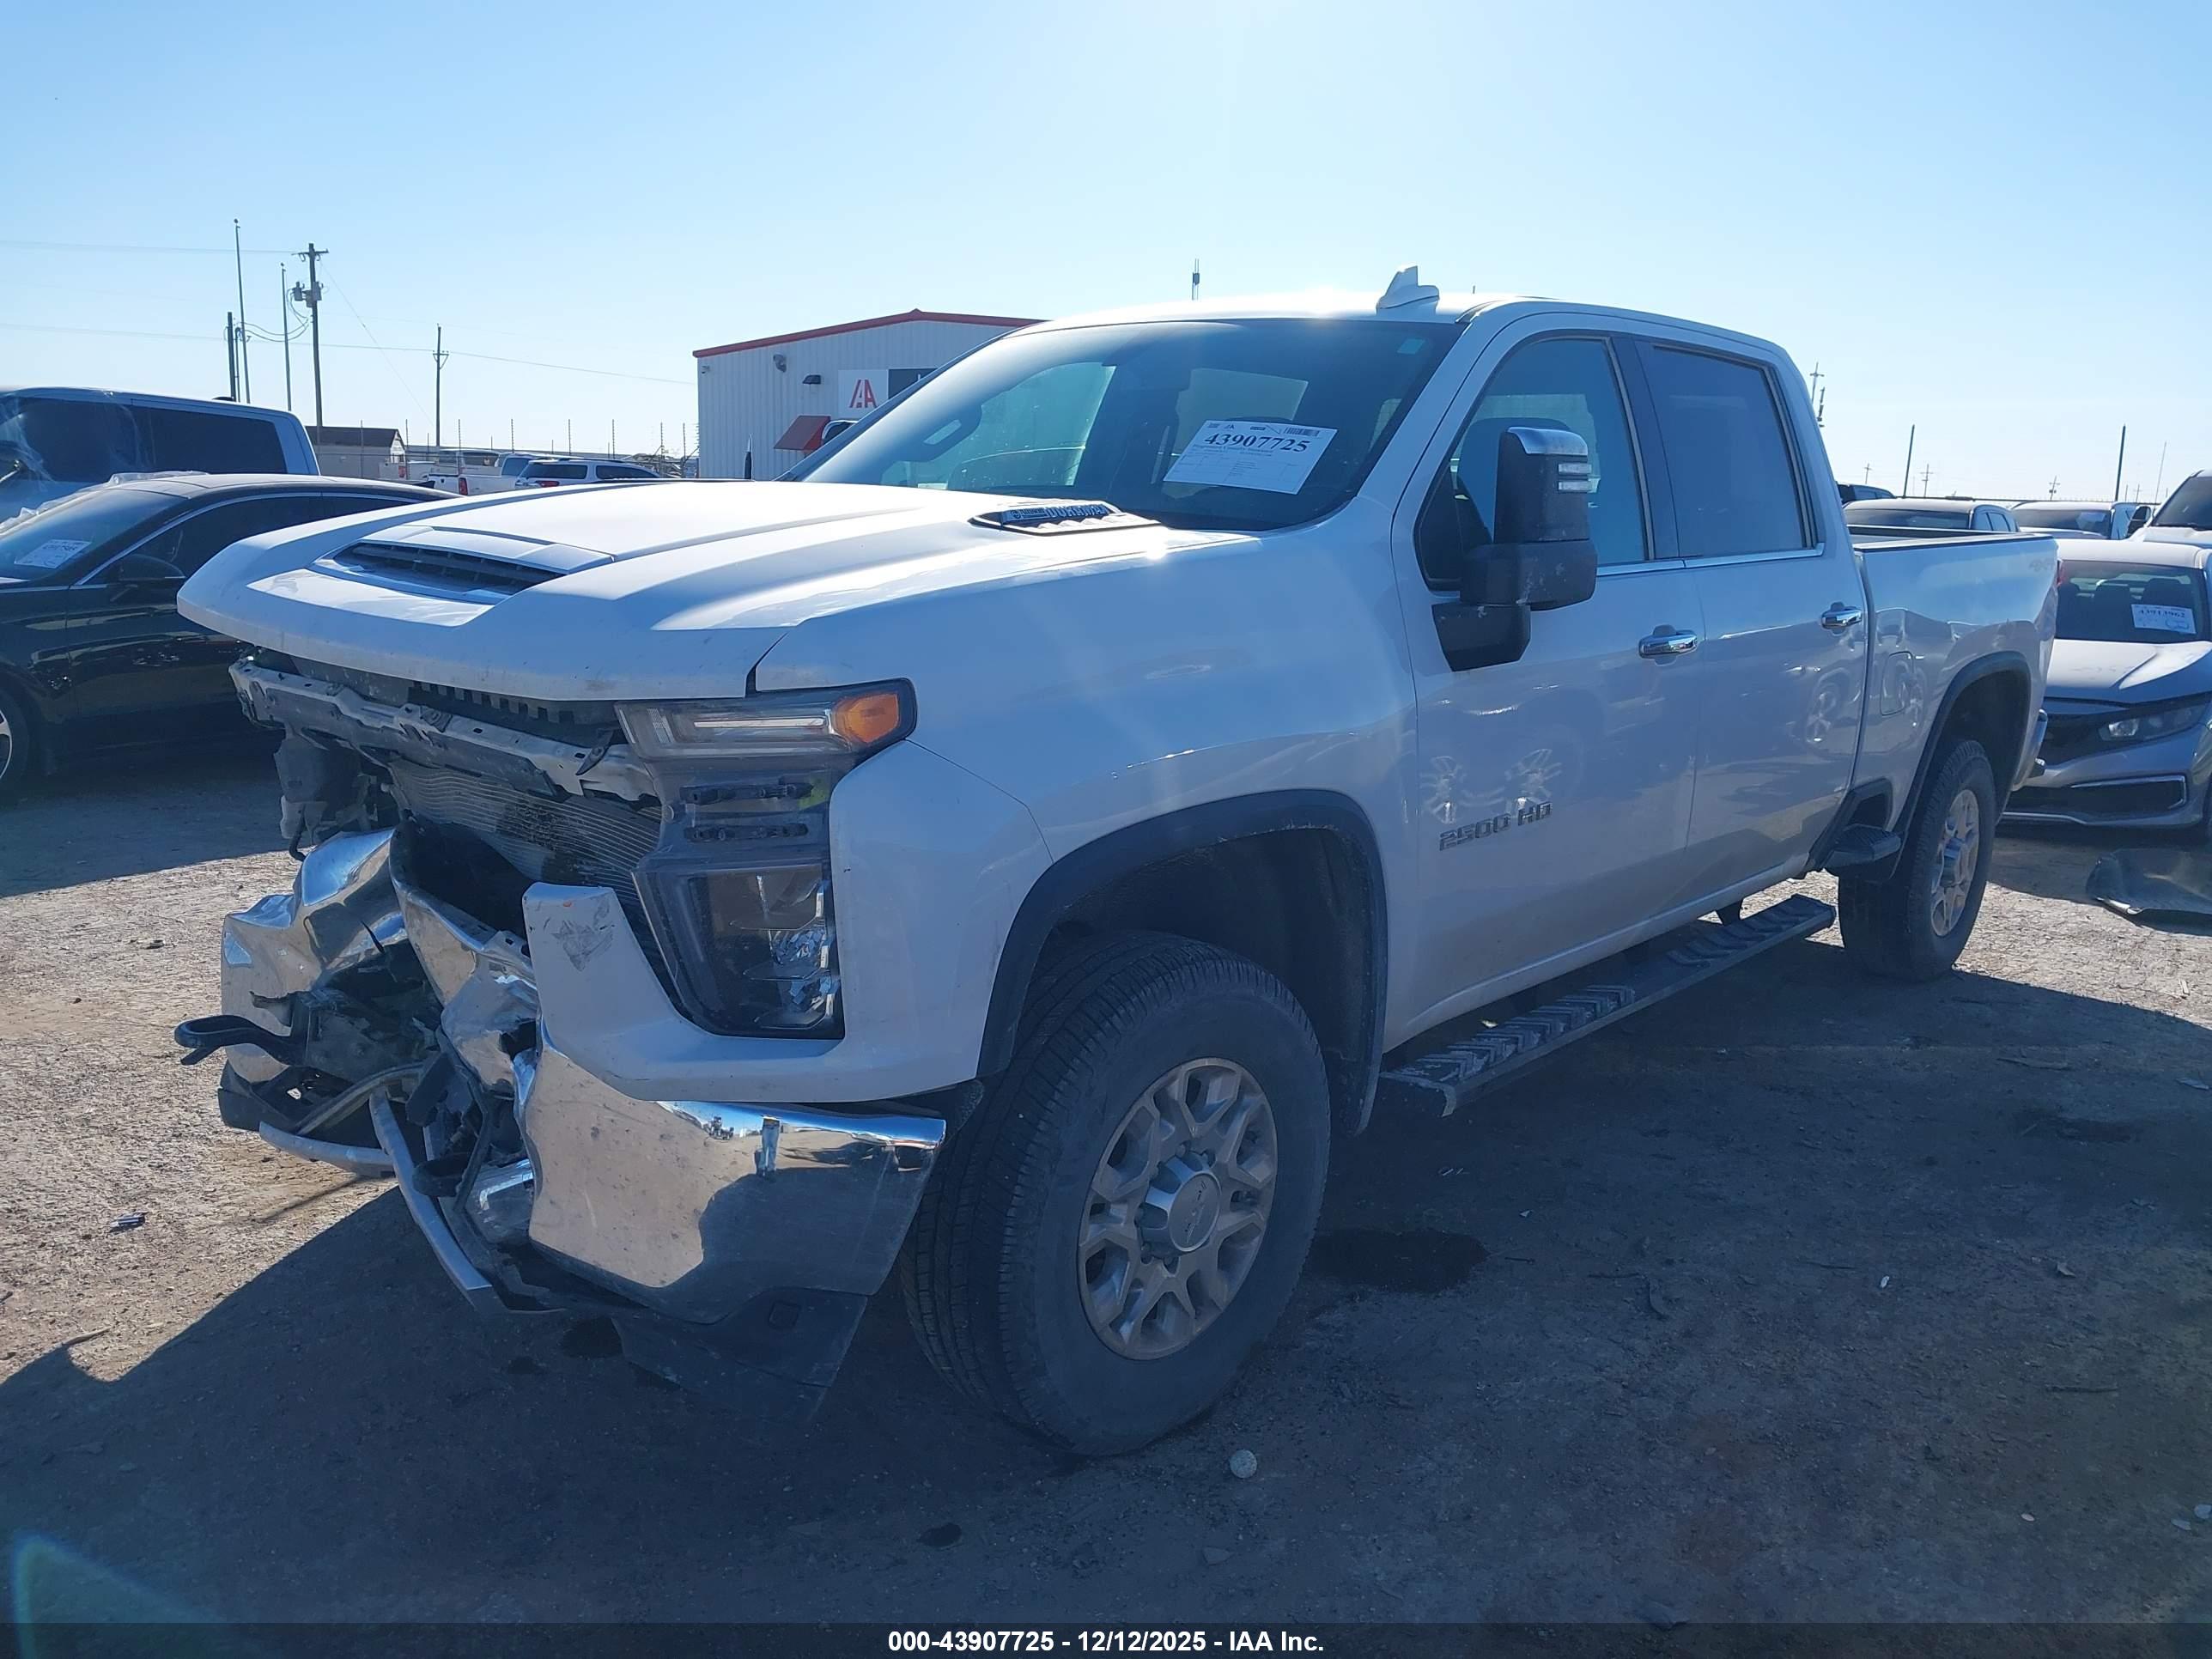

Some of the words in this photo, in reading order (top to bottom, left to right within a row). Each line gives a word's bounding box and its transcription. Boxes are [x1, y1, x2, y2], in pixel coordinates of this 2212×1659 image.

[1204, 432, 1312, 453] 43907725
[1439, 812, 1511, 851] 2500
[1517, 800, 1553, 826] HD
